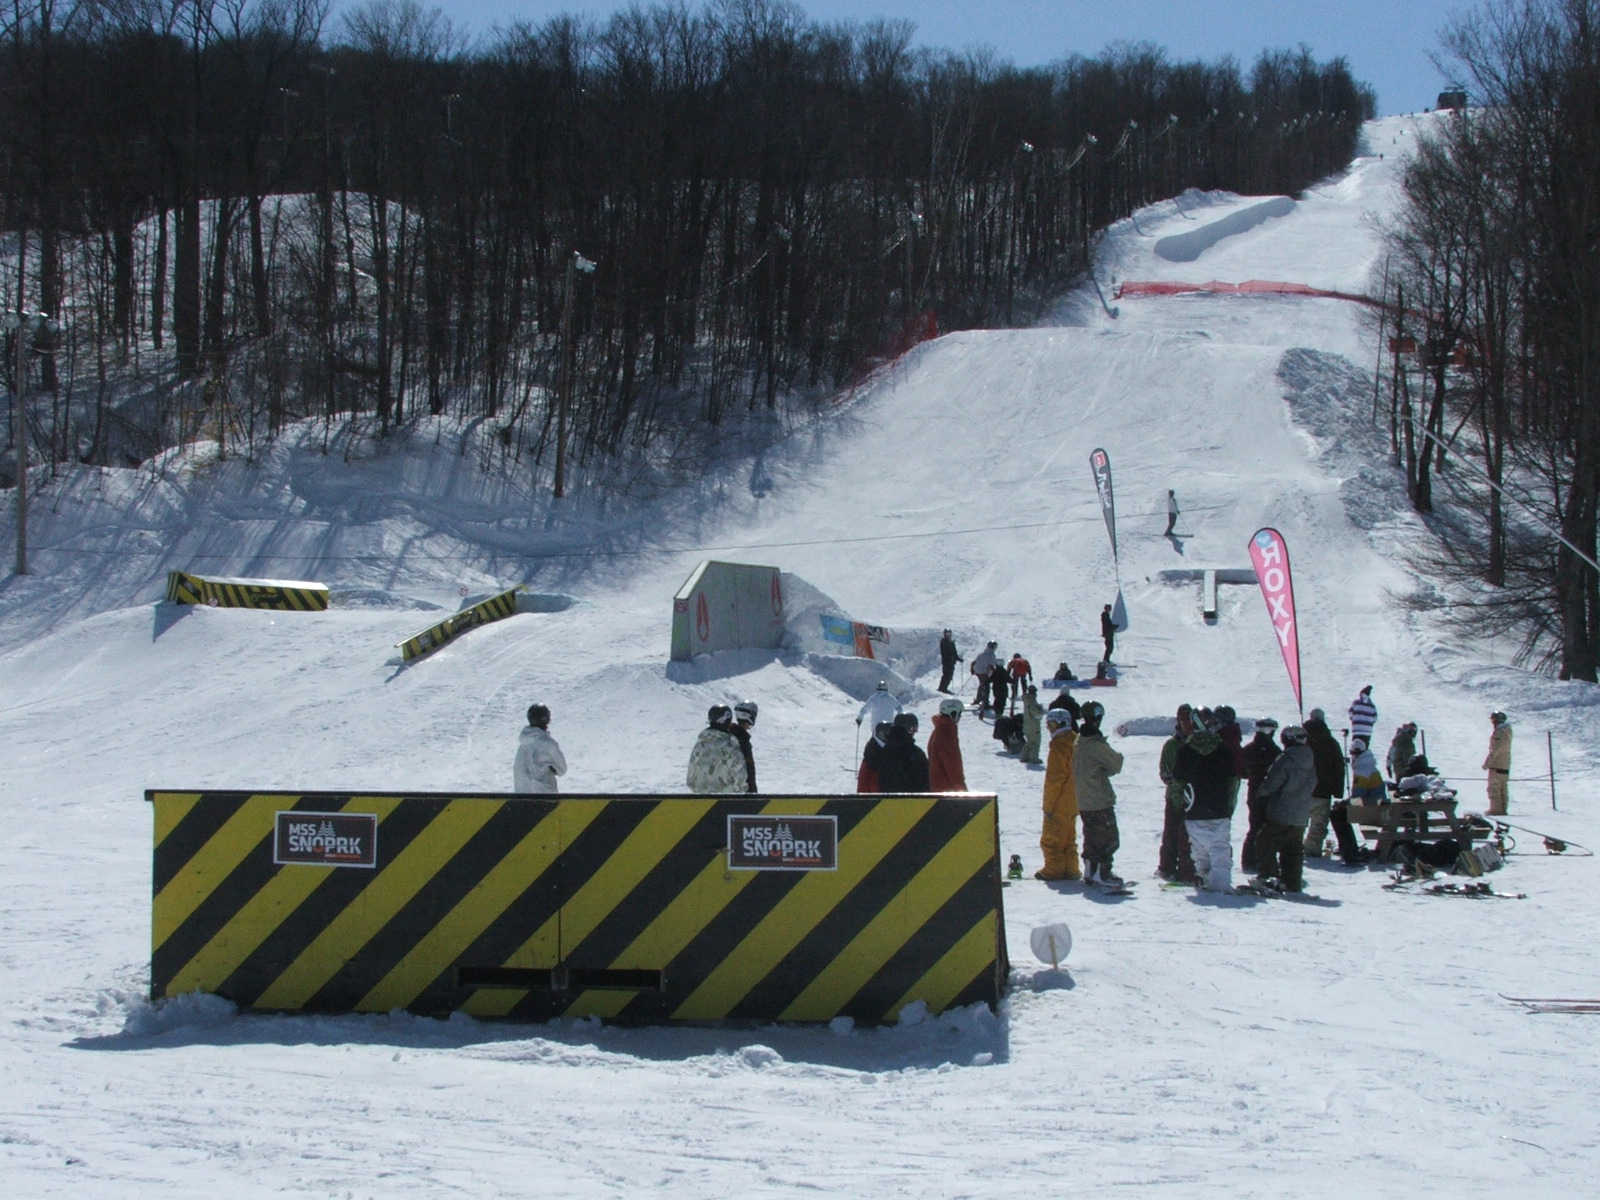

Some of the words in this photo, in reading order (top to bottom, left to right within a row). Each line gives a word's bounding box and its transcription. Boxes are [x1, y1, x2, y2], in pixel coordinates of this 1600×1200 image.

[288, 823, 317, 836] MSS
[743, 827, 773, 840] MSS
[288, 835, 362, 854] SNOPRK
[743, 840, 822, 858] SNOPRK
